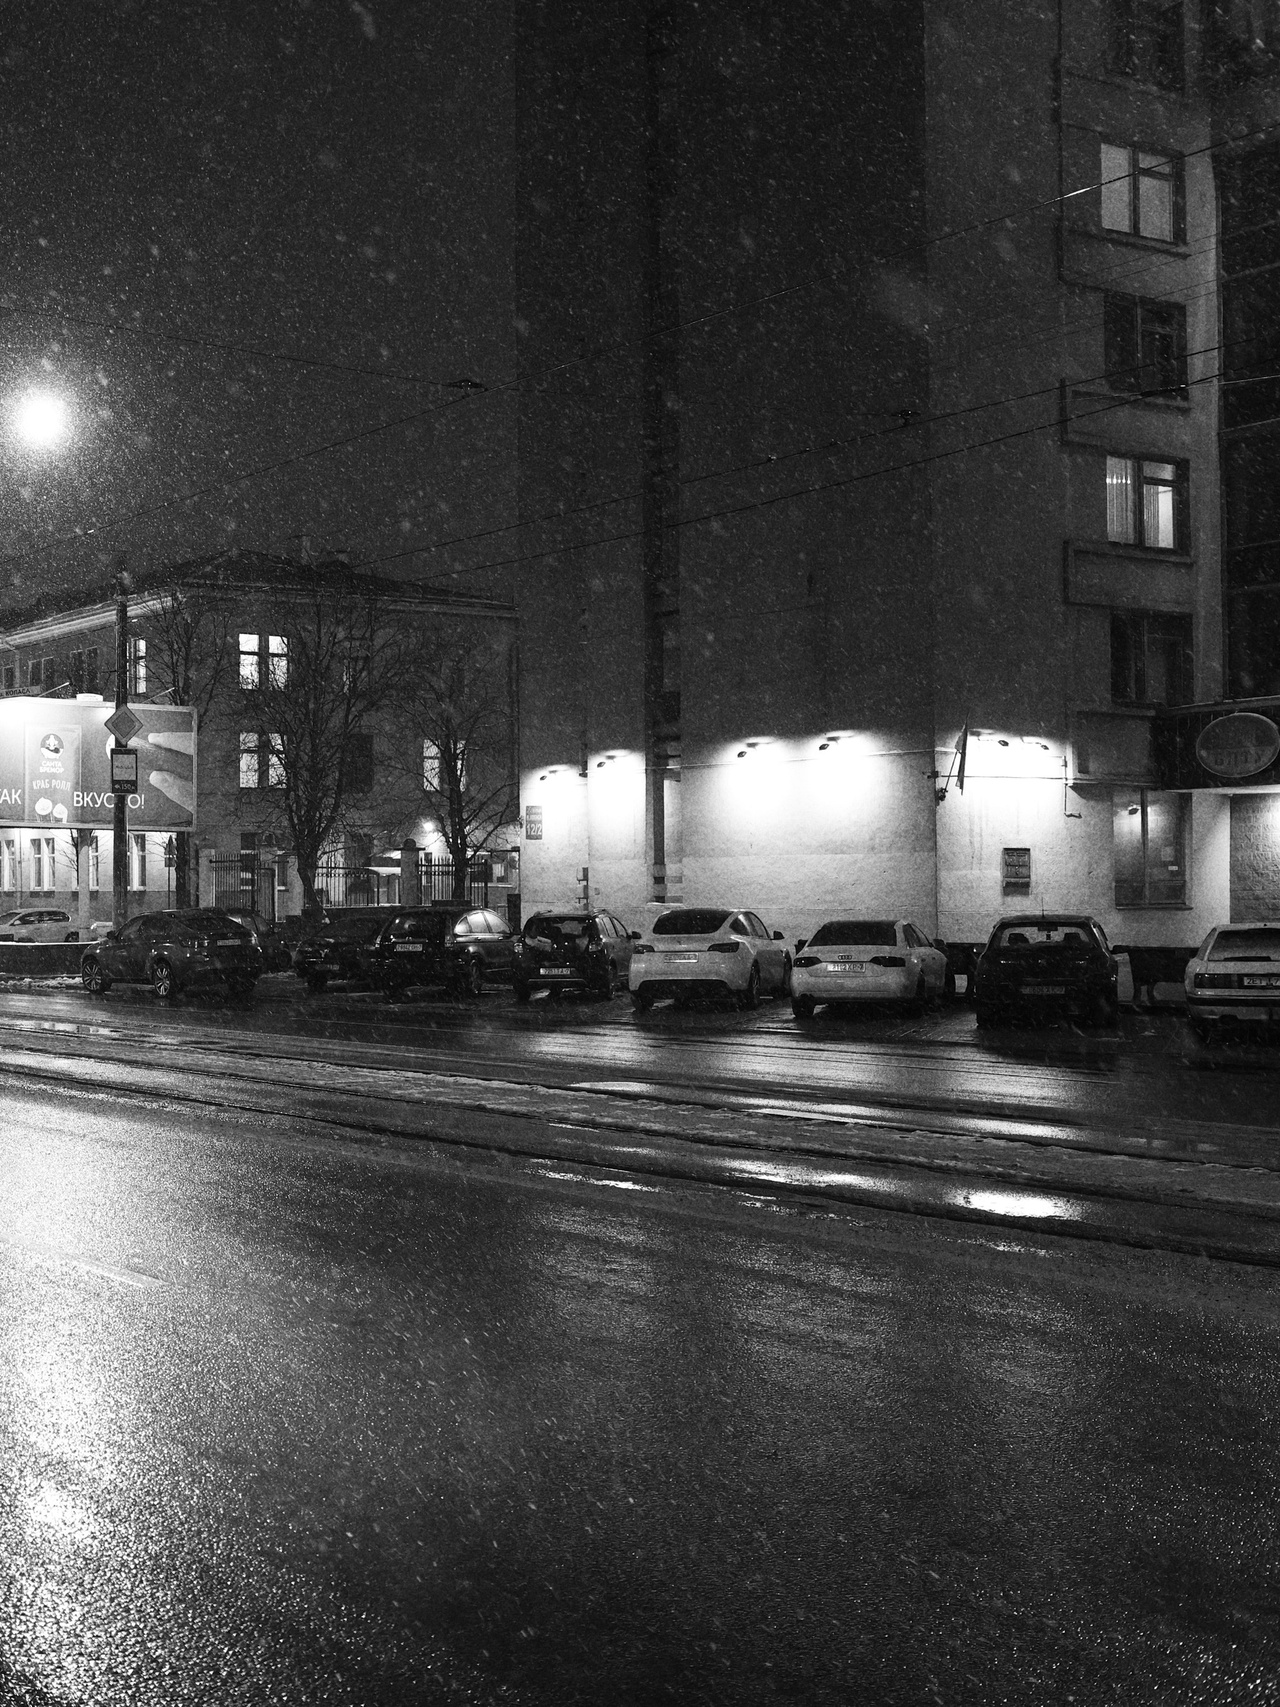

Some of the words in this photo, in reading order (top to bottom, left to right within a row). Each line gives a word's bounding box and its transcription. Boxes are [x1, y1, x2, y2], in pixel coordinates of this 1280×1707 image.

[32, 779, 50, 790] КРАБ
[51, 779, 71, 791] РОЛЛ
[73, 791, 145, 809] ВКУСО!
[526, 823, 542, 835] 12/2
